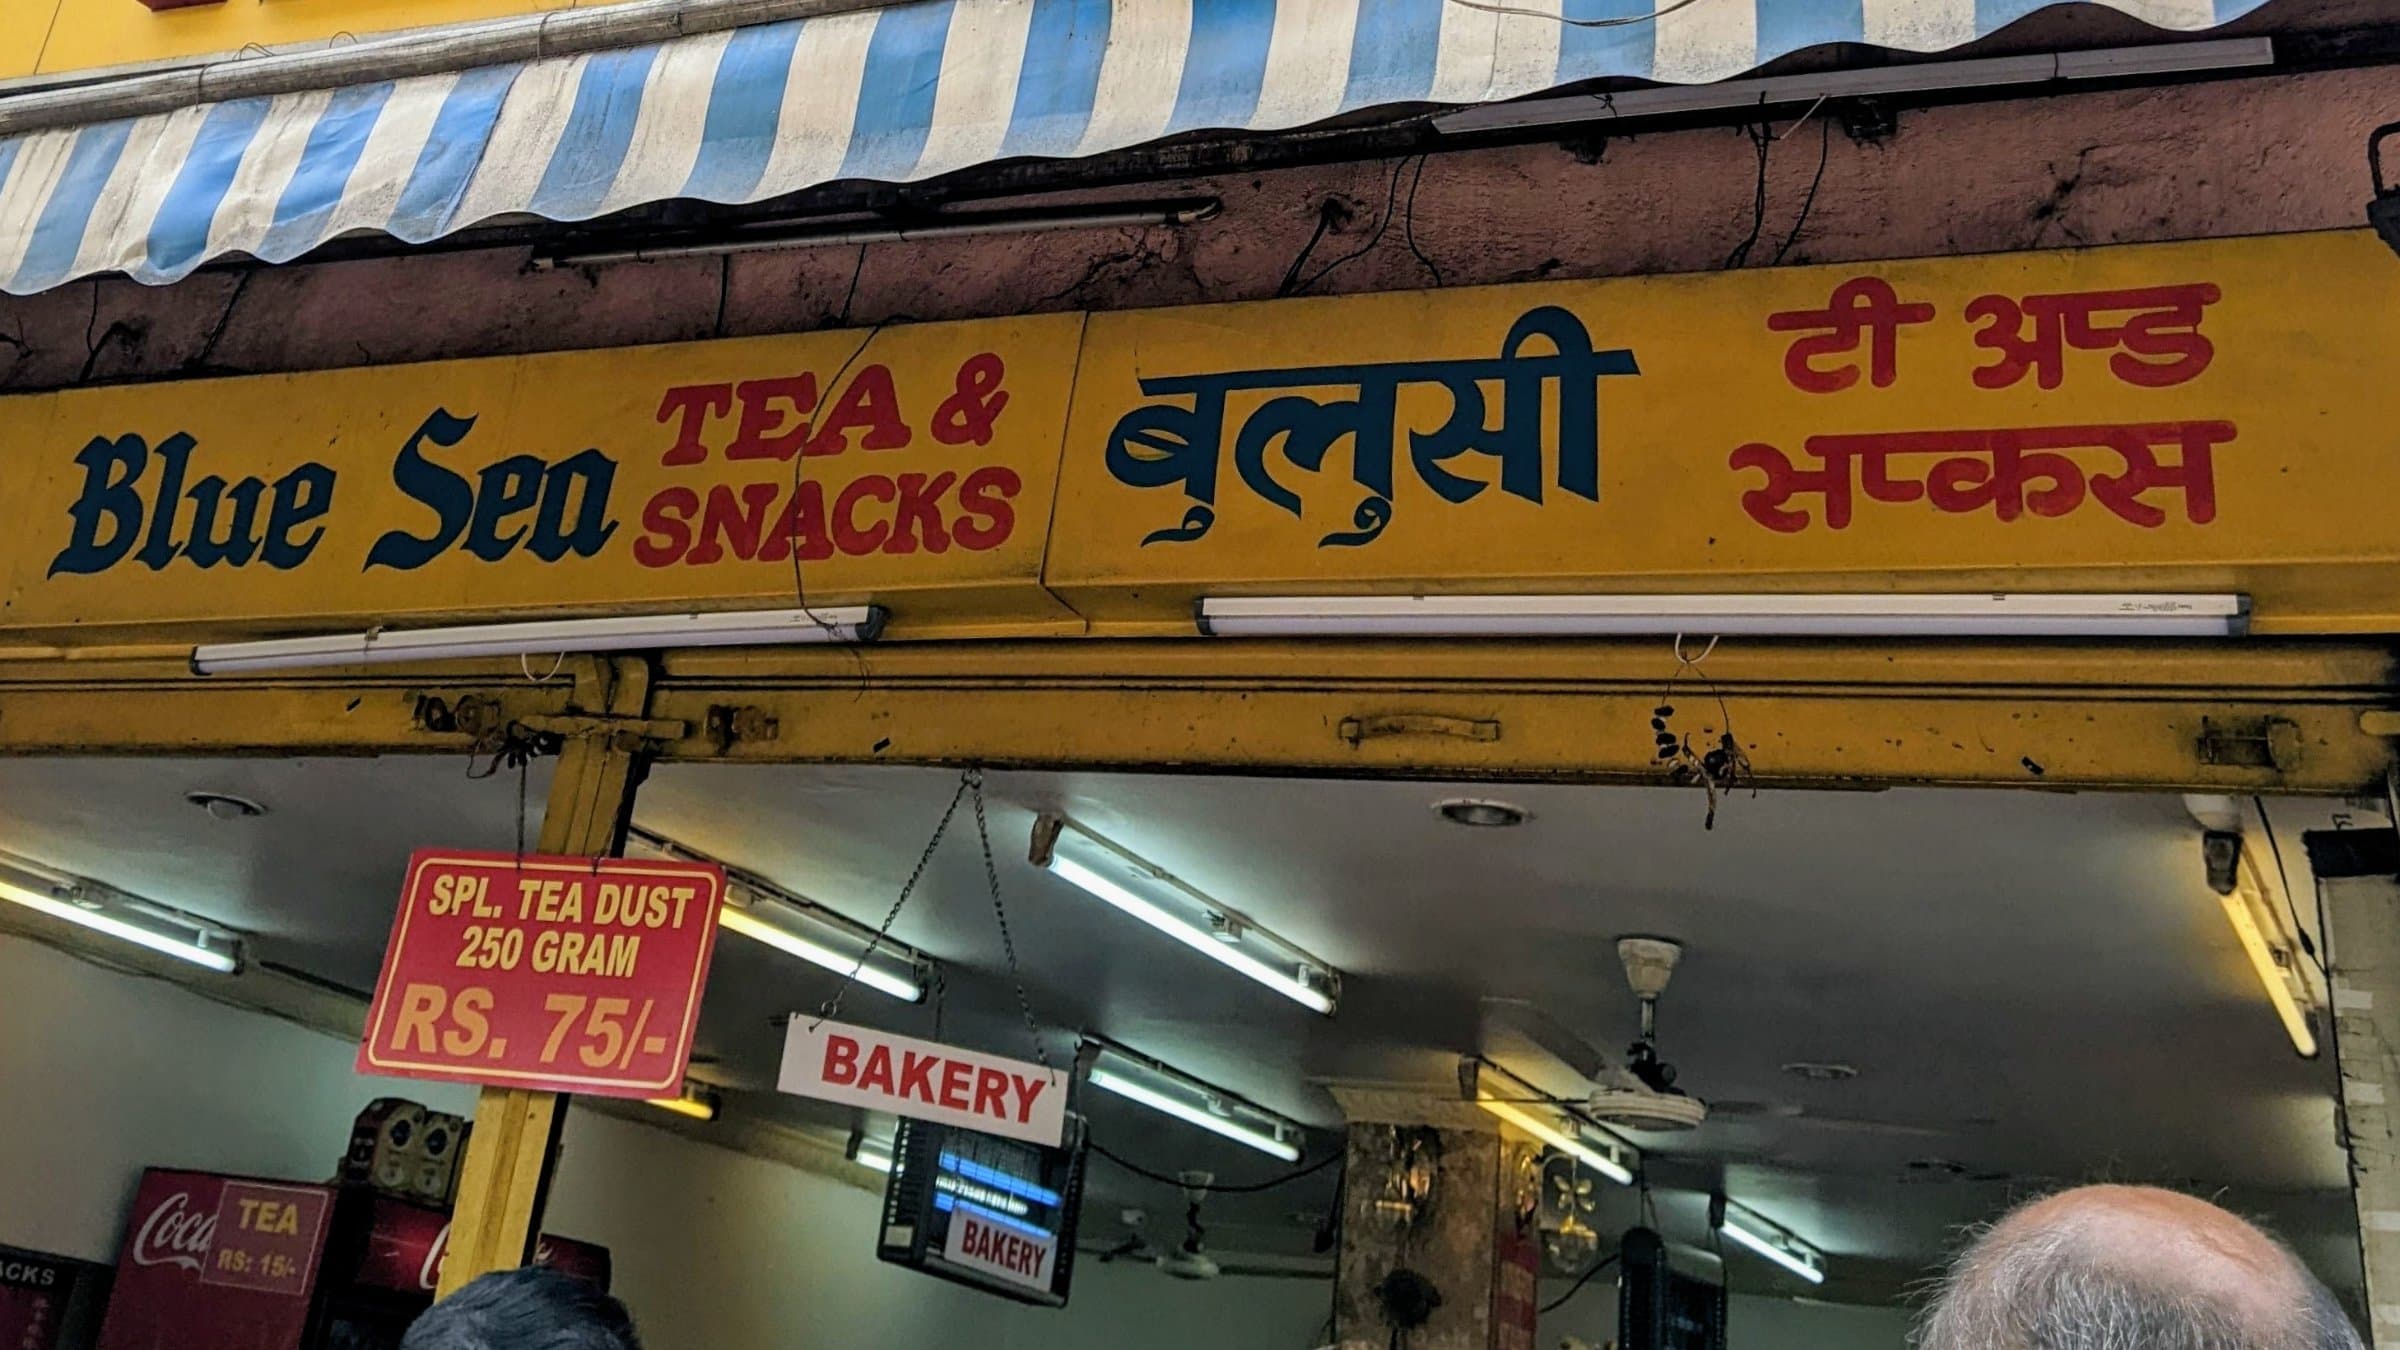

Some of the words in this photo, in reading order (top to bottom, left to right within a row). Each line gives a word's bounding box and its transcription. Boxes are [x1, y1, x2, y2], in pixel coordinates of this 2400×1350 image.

[1767, 276, 1935, 393] टी
[655, 364, 912, 466] TEA
[931, 352, 1010, 447] &
[1105, 305, 1640, 548] बुलुसी
[46, 431, 337, 581] Blue
[362, 407, 620, 573] Sea
[633, 465, 1022, 568] SNACKS
[429, 874, 503, 918] SPL.
[518, 879, 583, 923] TEA
[592, 884, 696, 929] DUST
[456, 926, 523, 970] 250
[531, 932, 640, 978] GRAM
[390, 983, 507, 1059] RS.
[539, 994, 667, 1070] 75/-
[820, 1034, 1048, 1124] BAKERY
[239, 1198, 298, 1235] TEA
[962, 1219, 1047, 1278] BAKERY
[261, 1253, 296, 1279] 15/-
